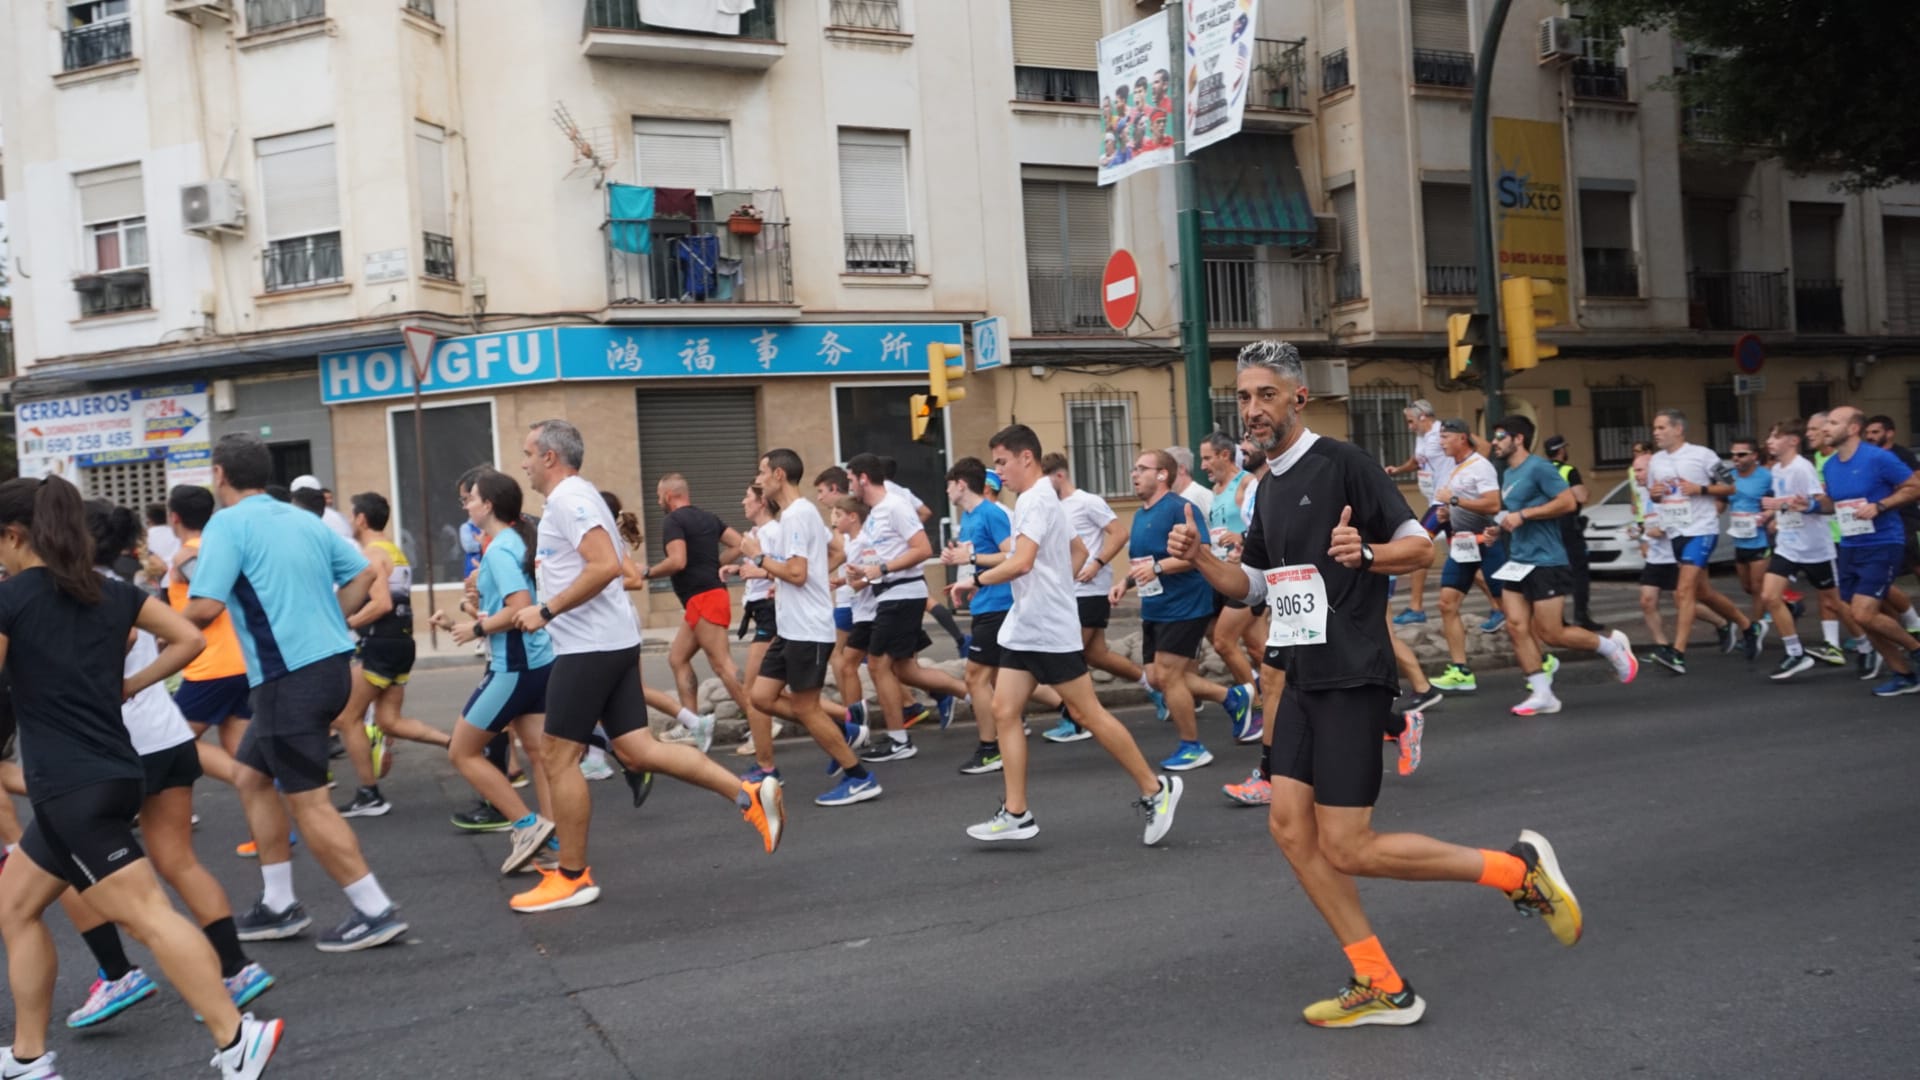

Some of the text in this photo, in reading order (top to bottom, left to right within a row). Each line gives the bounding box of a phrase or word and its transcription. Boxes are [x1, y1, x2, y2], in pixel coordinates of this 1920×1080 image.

[1499, 175, 1562, 211] Sixto
[606, 328, 913, 374] 鸿福事务所
[19, 393, 130, 422] CERRAJEROS
[159, 399, 176, 417] 24
[47, 437, 72, 453] 690
[76, 434, 102, 450] 258
[106, 431, 133, 447] 485
[1277, 593, 1315, 617] 9063
